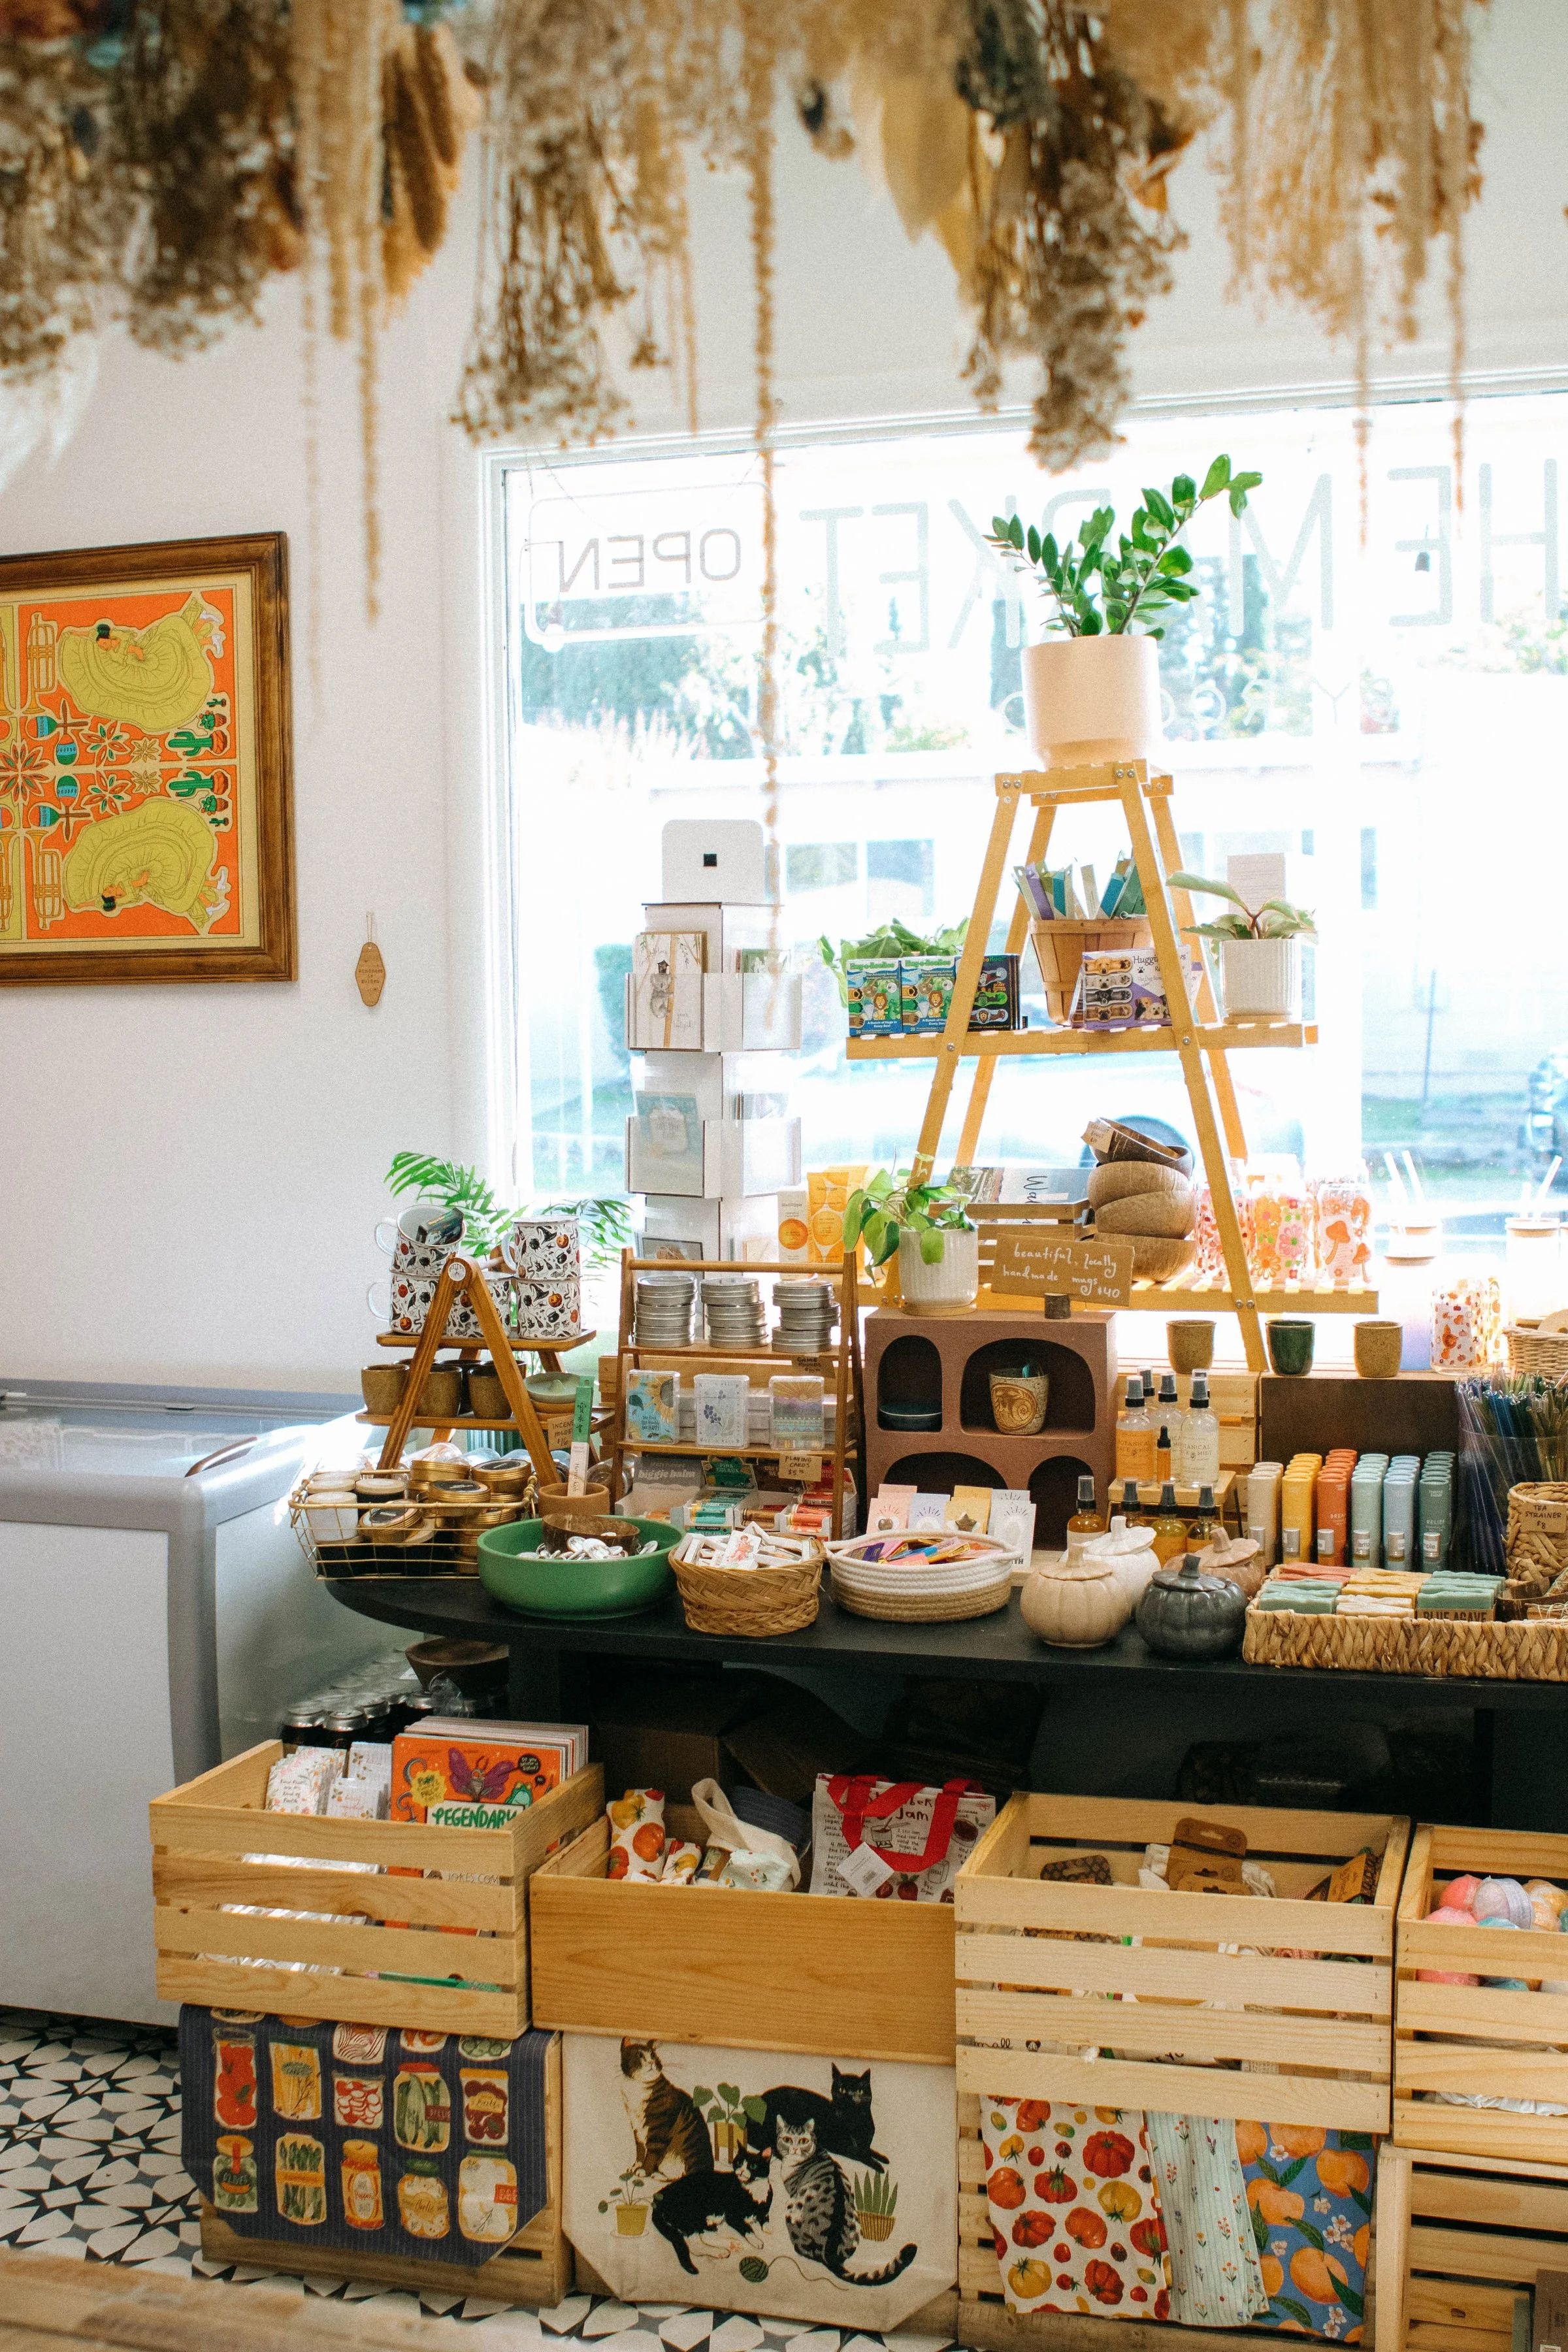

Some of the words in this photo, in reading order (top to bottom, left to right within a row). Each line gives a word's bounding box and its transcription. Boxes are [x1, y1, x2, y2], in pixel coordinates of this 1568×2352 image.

[1132, 954, 1158, 966] Huggi
[1014, 1243, 1078, 1266] beautiful,
[1084, 1253, 1117, 1279] locally
[1003, 1265, 1058, 1281] handmade
[1071, 1277, 1098, 1296] mugs
[1097, 1286, 1120, 1298] $40
[552, 1420, 573, 1429] INCEN
[638, 1470, 669, 1480] biggie
[670, 1469, 696, 1478] balm
[1525, 1511, 1562, 1519] STRAINER
[1423, 1610, 1450, 1620] BLUE
[1454, 1611, 1488, 1622] AGAVE
[895, 1807, 929, 1821] Jam
[973, 2037, 1011, 2049] mall
